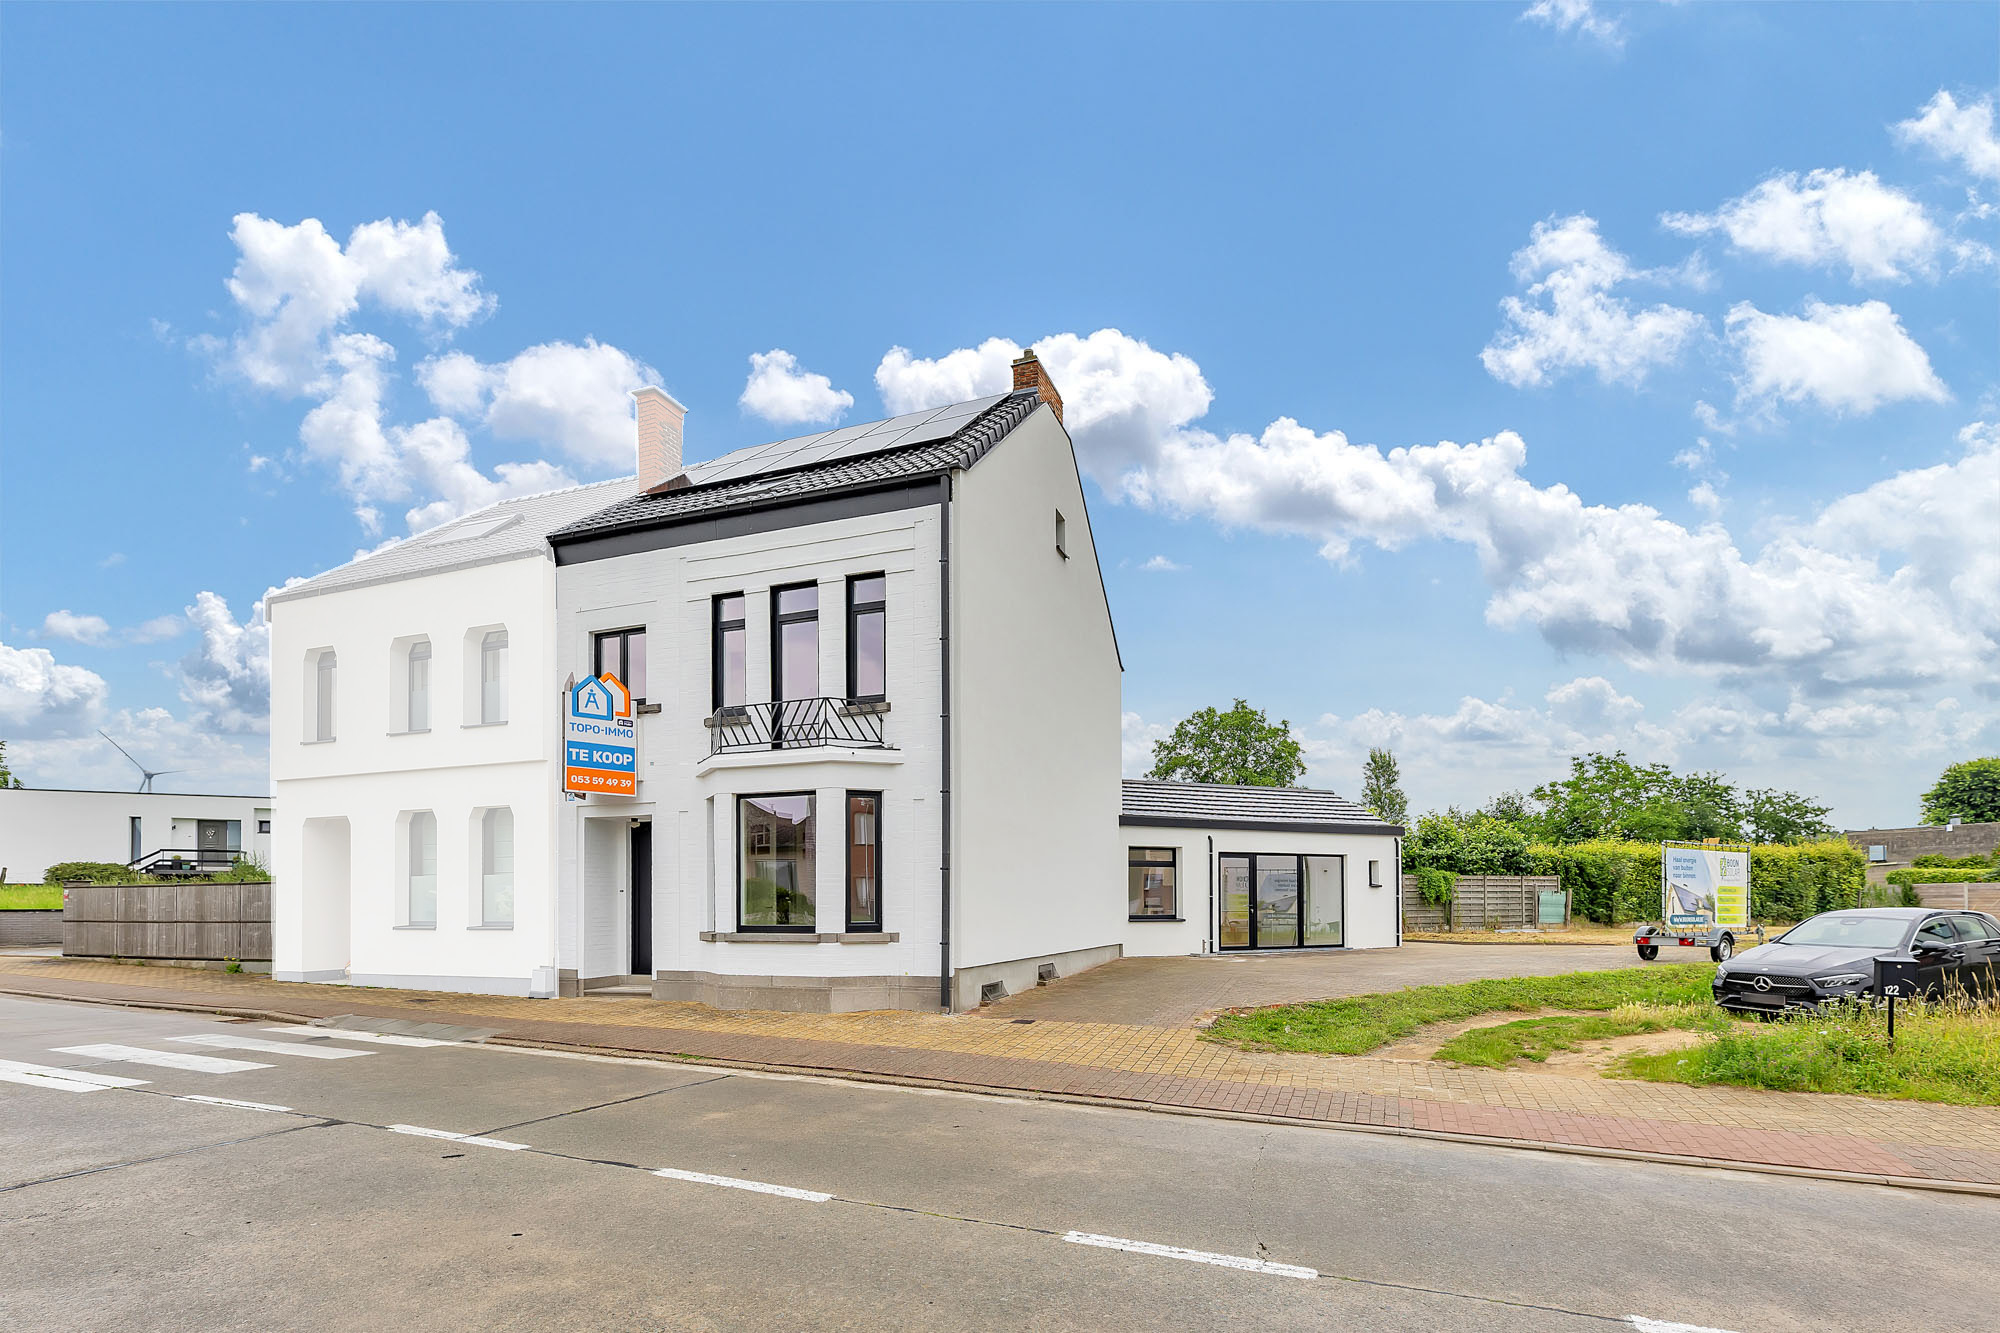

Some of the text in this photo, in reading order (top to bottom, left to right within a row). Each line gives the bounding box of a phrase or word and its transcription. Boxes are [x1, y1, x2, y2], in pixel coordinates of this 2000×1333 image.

[569, 722, 633, 738] TOPO-IMMO
[569, 748, 633, 766] TE KOOP
[571, 775, 632, 788] 053 59 49 39
[1884, 985, 1899, 995] 122
